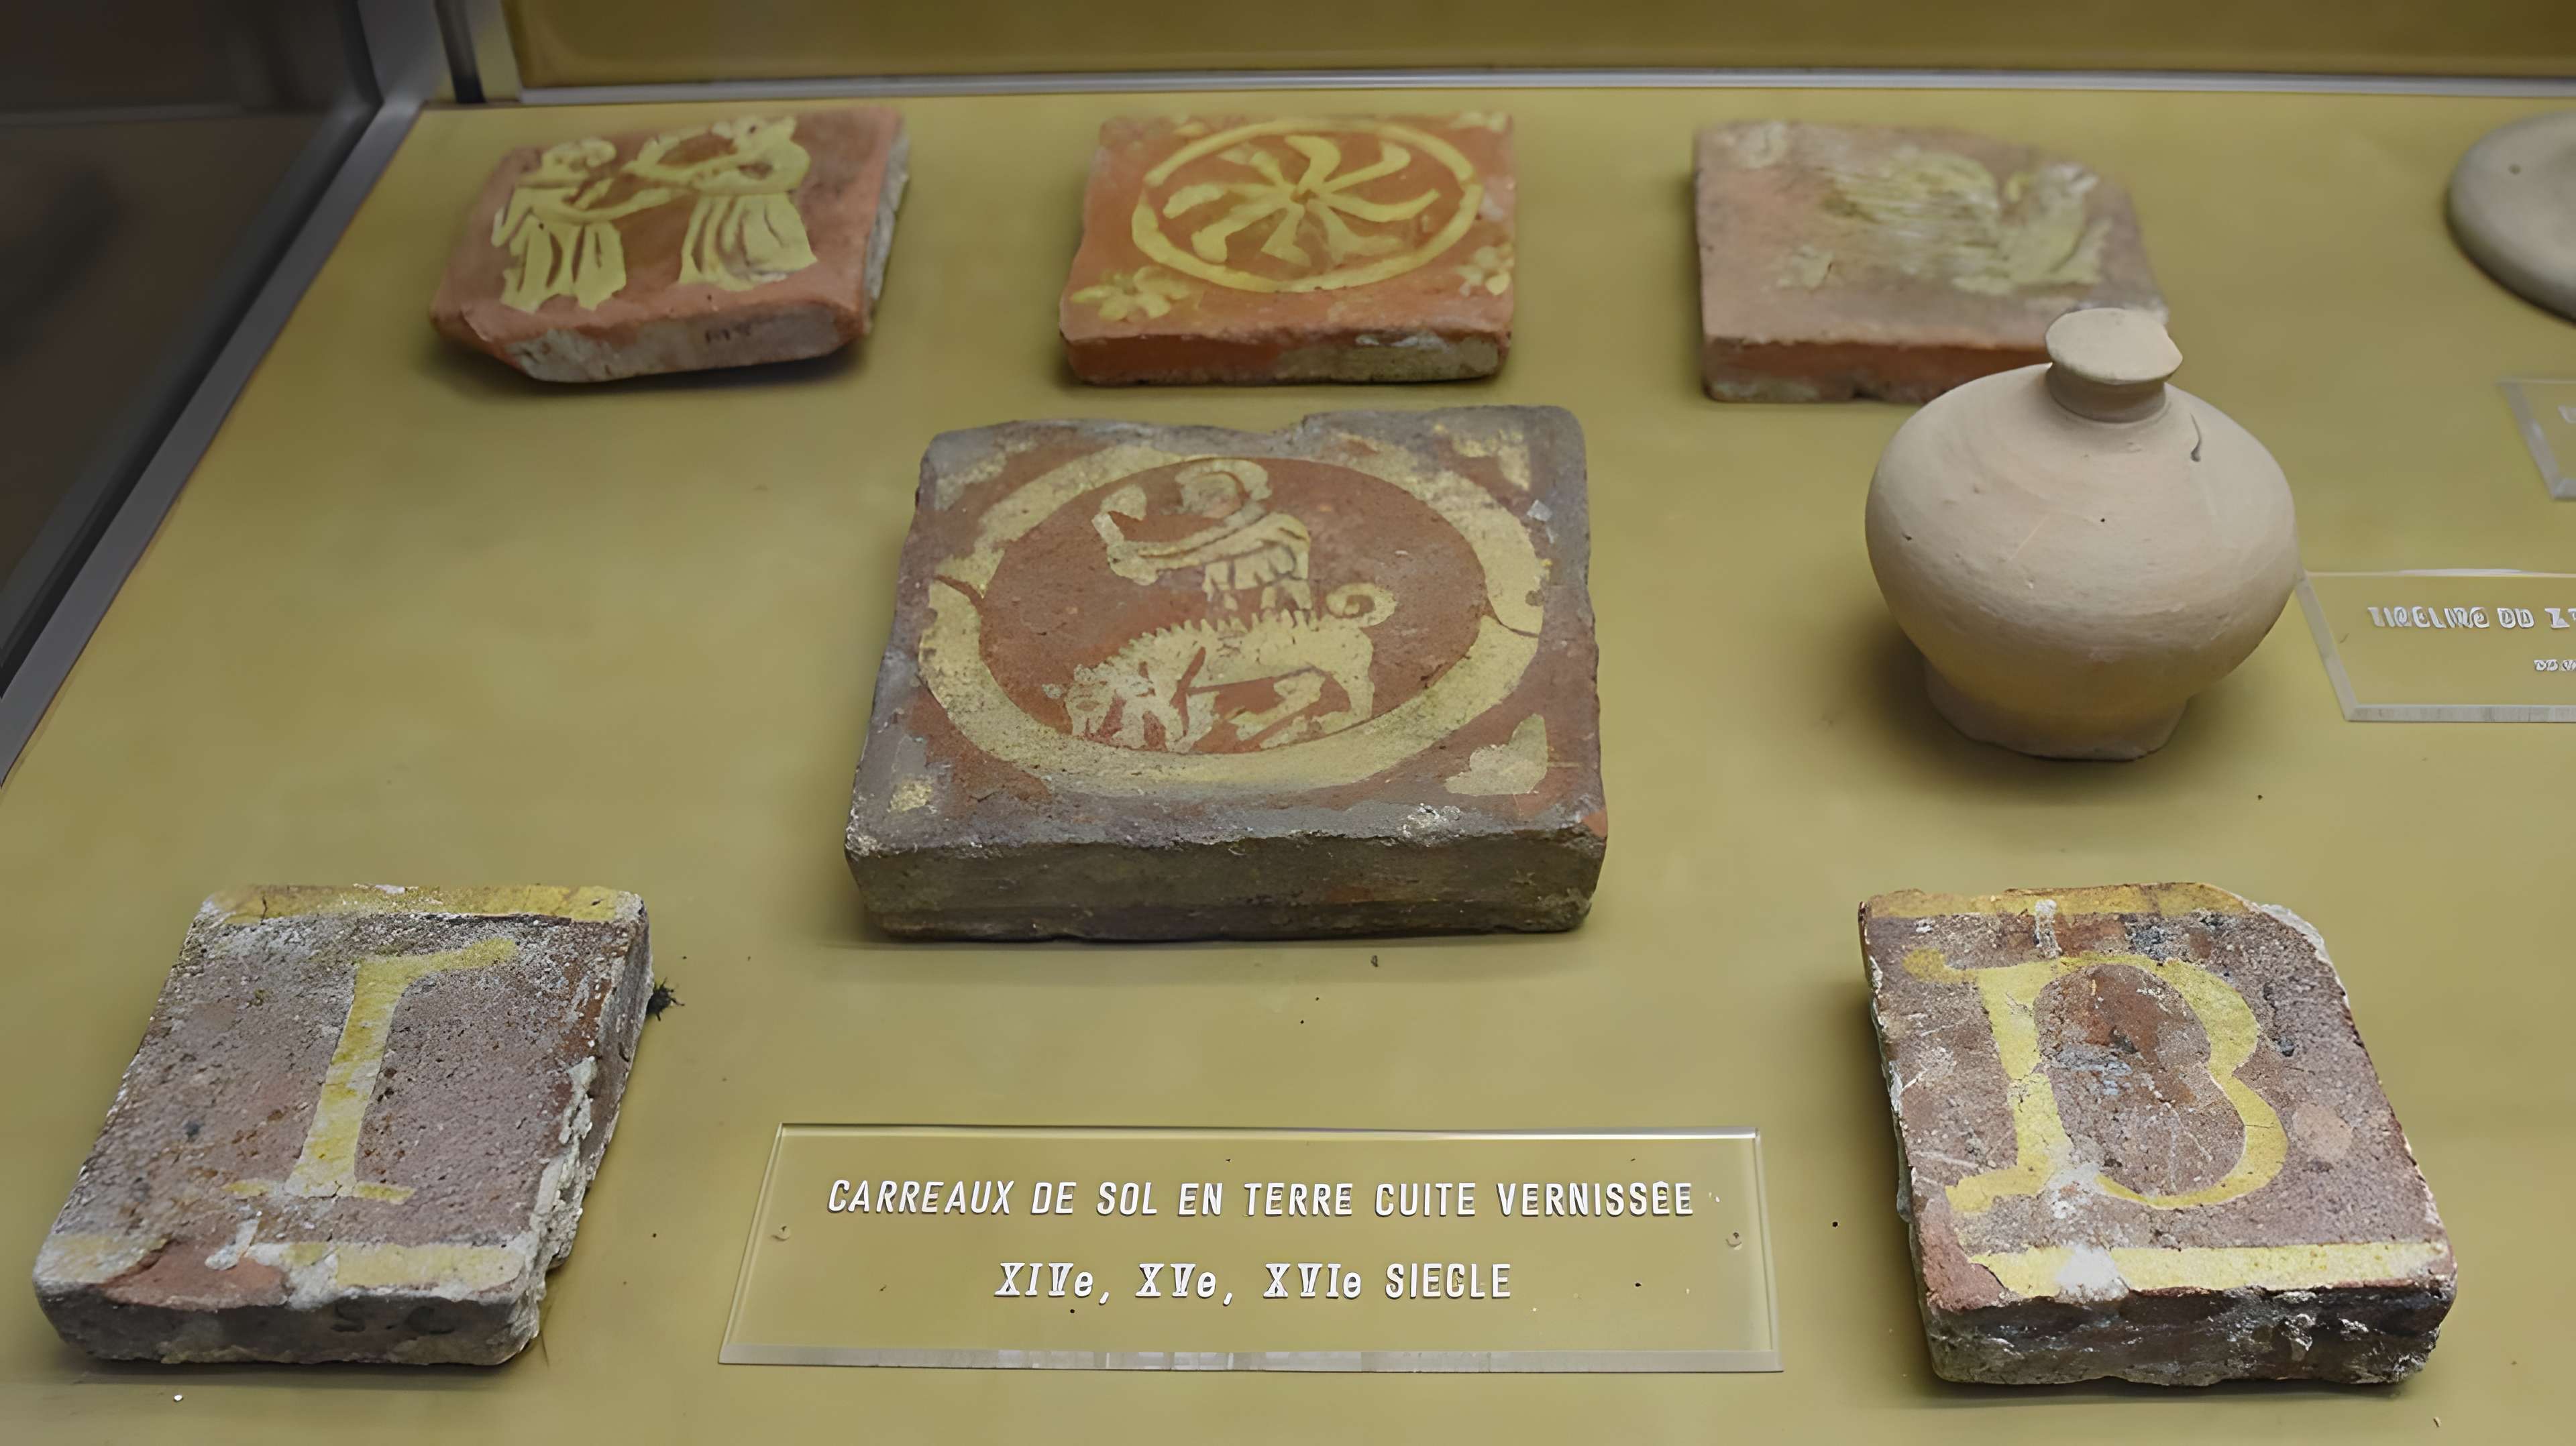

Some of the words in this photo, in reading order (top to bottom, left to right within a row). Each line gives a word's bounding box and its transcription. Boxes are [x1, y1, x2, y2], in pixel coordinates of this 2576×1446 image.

[828, 1178, 1015, 1215] CARREAUX
[1031, 1181, 1077, 1215] DE
[1096, 1180, 1158, 1216] SOL
[1178, 1182, 1224, 1216] EN
[1243, 1182, 1354, 1217] TERRE
[1375, 1182, 1477, 1217] CUITE
[994, 1262, 1110, 1305] XIVe,
[1134, 1262, 1234, 1306] XVe,
[1263, 1262, 1362, 1298] XVIe
[1385, 1262, 1511, 1298] SIECLE
